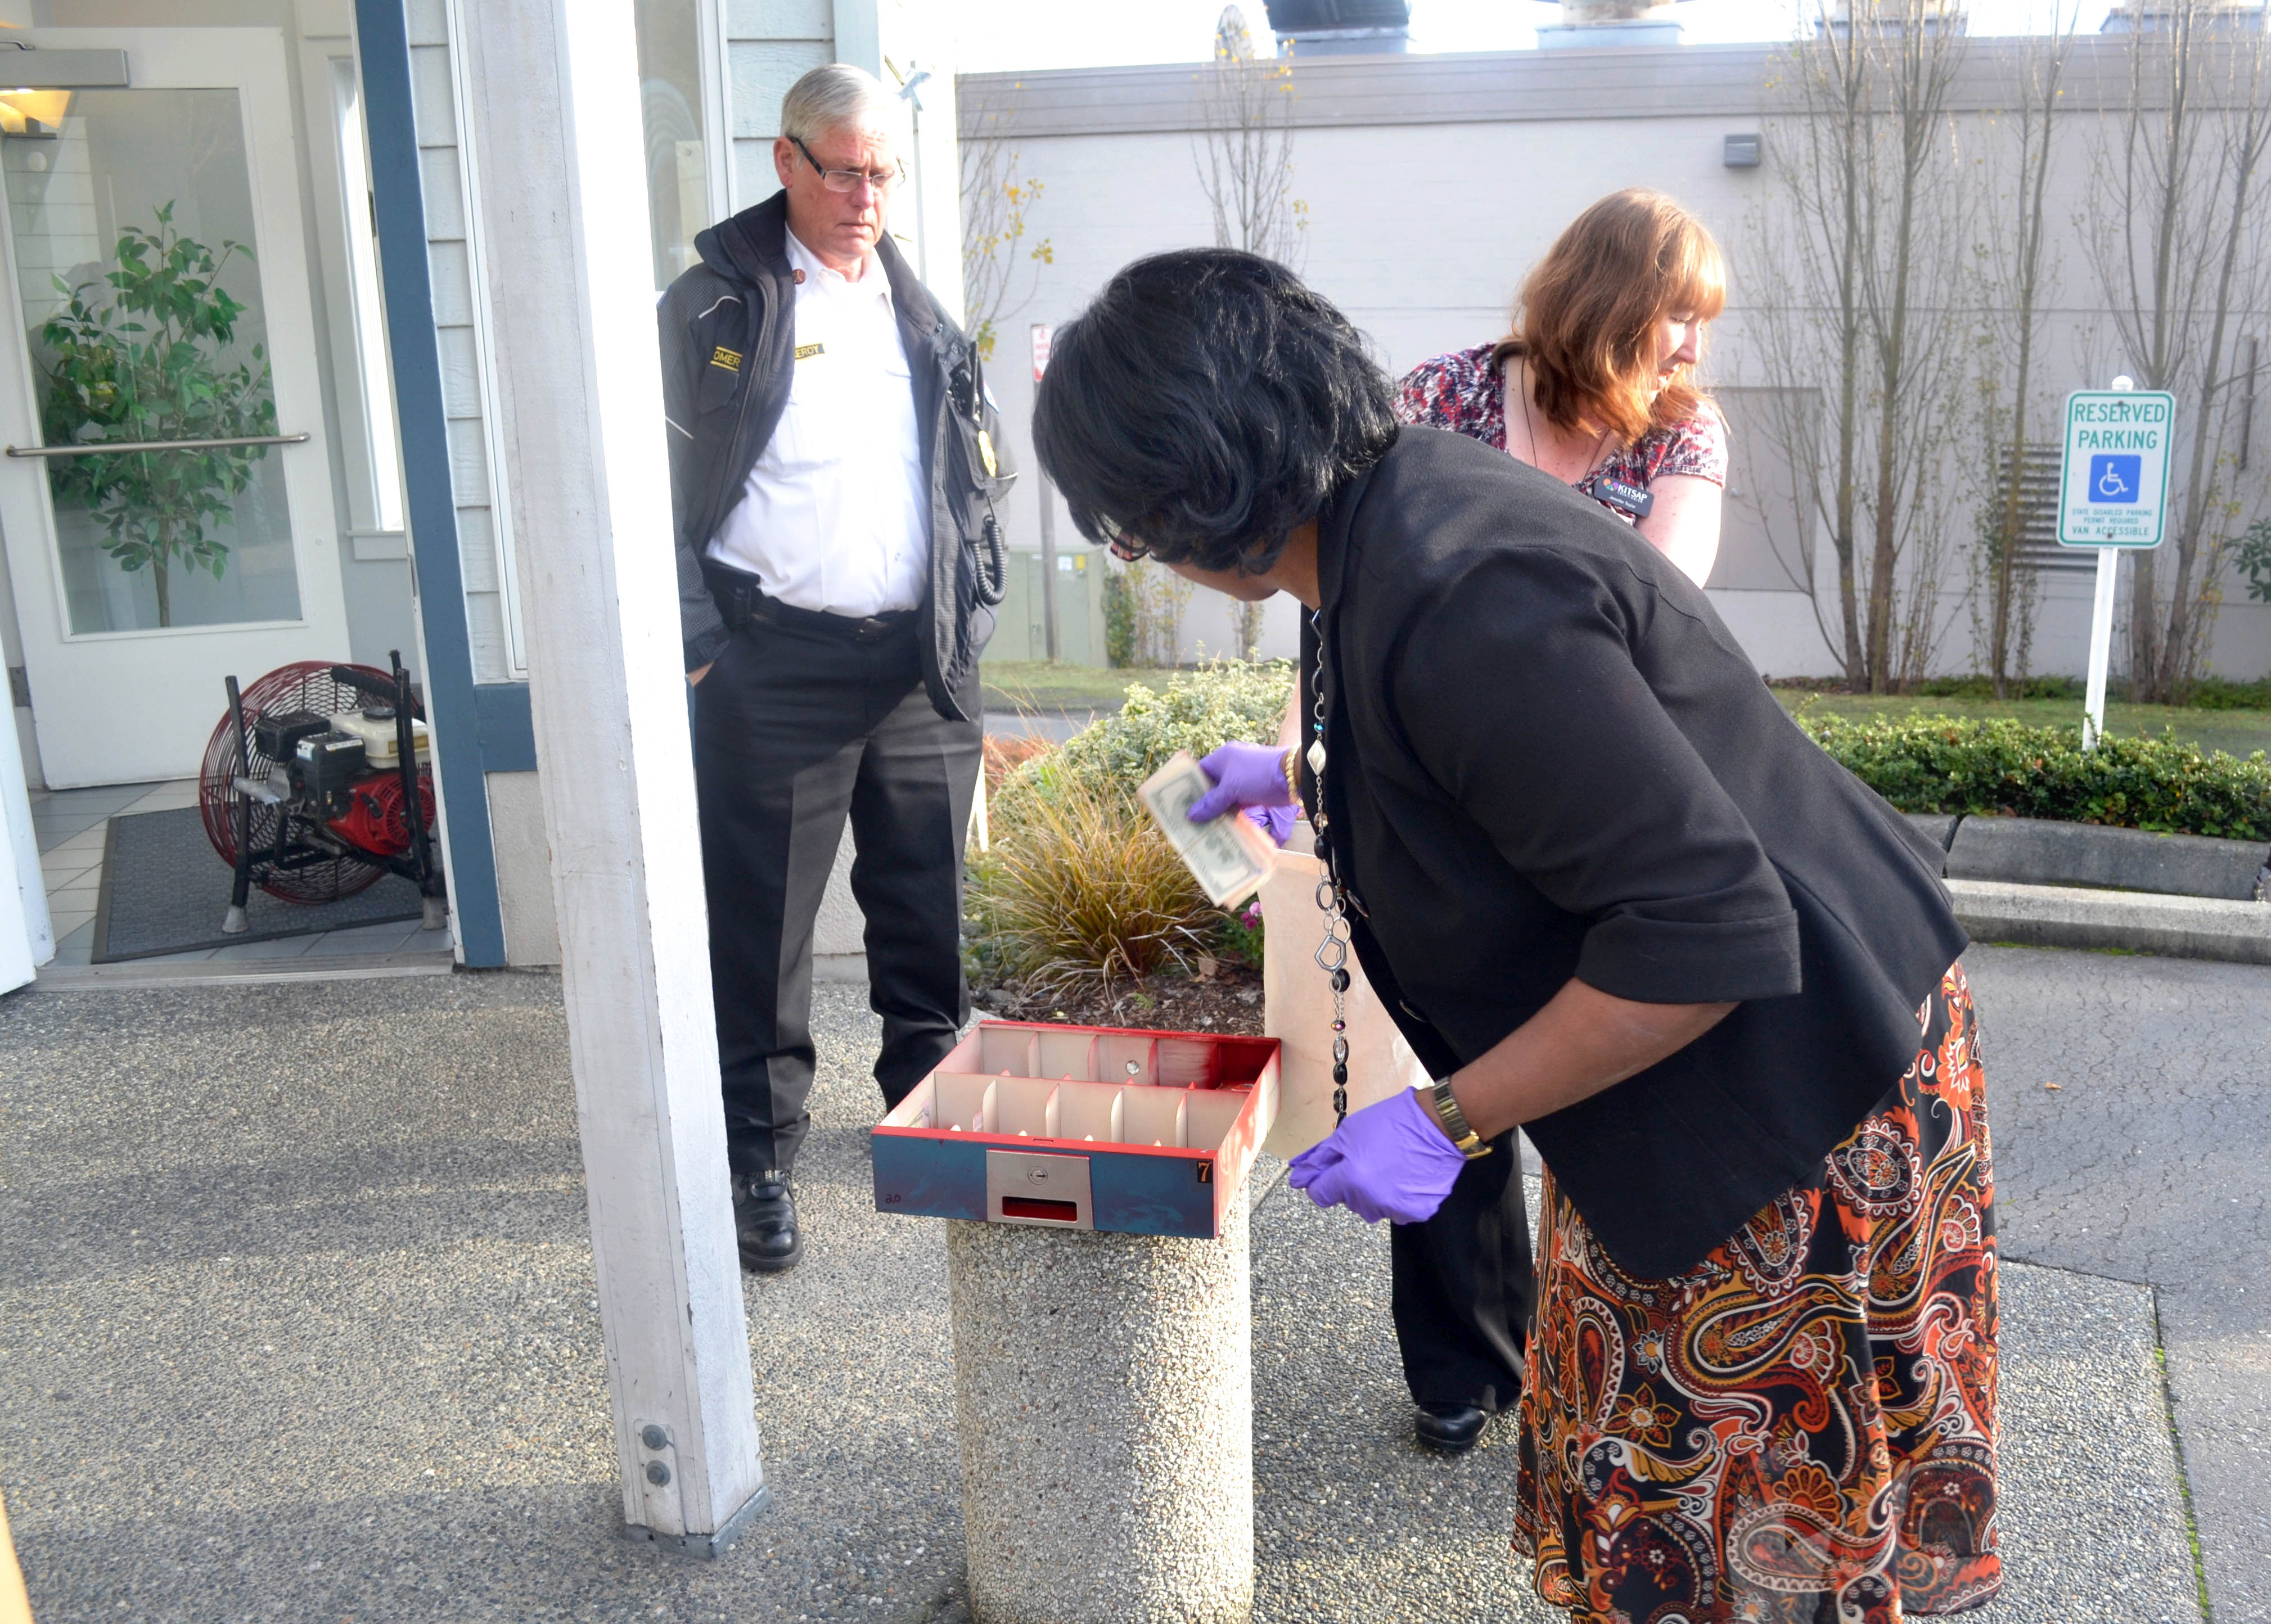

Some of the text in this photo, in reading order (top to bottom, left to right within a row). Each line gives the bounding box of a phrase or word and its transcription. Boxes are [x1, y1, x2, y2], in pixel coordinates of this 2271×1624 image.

[2074, 404, 2165, 422] RESERVED
[2078, 430, 2157, 449] PARKING
[1617, 484, 1648, 502] KITSAP
[2096, 527, 2150, 536] ACCESSIBLE
[1198, 1162, 1210, 1182] 7
